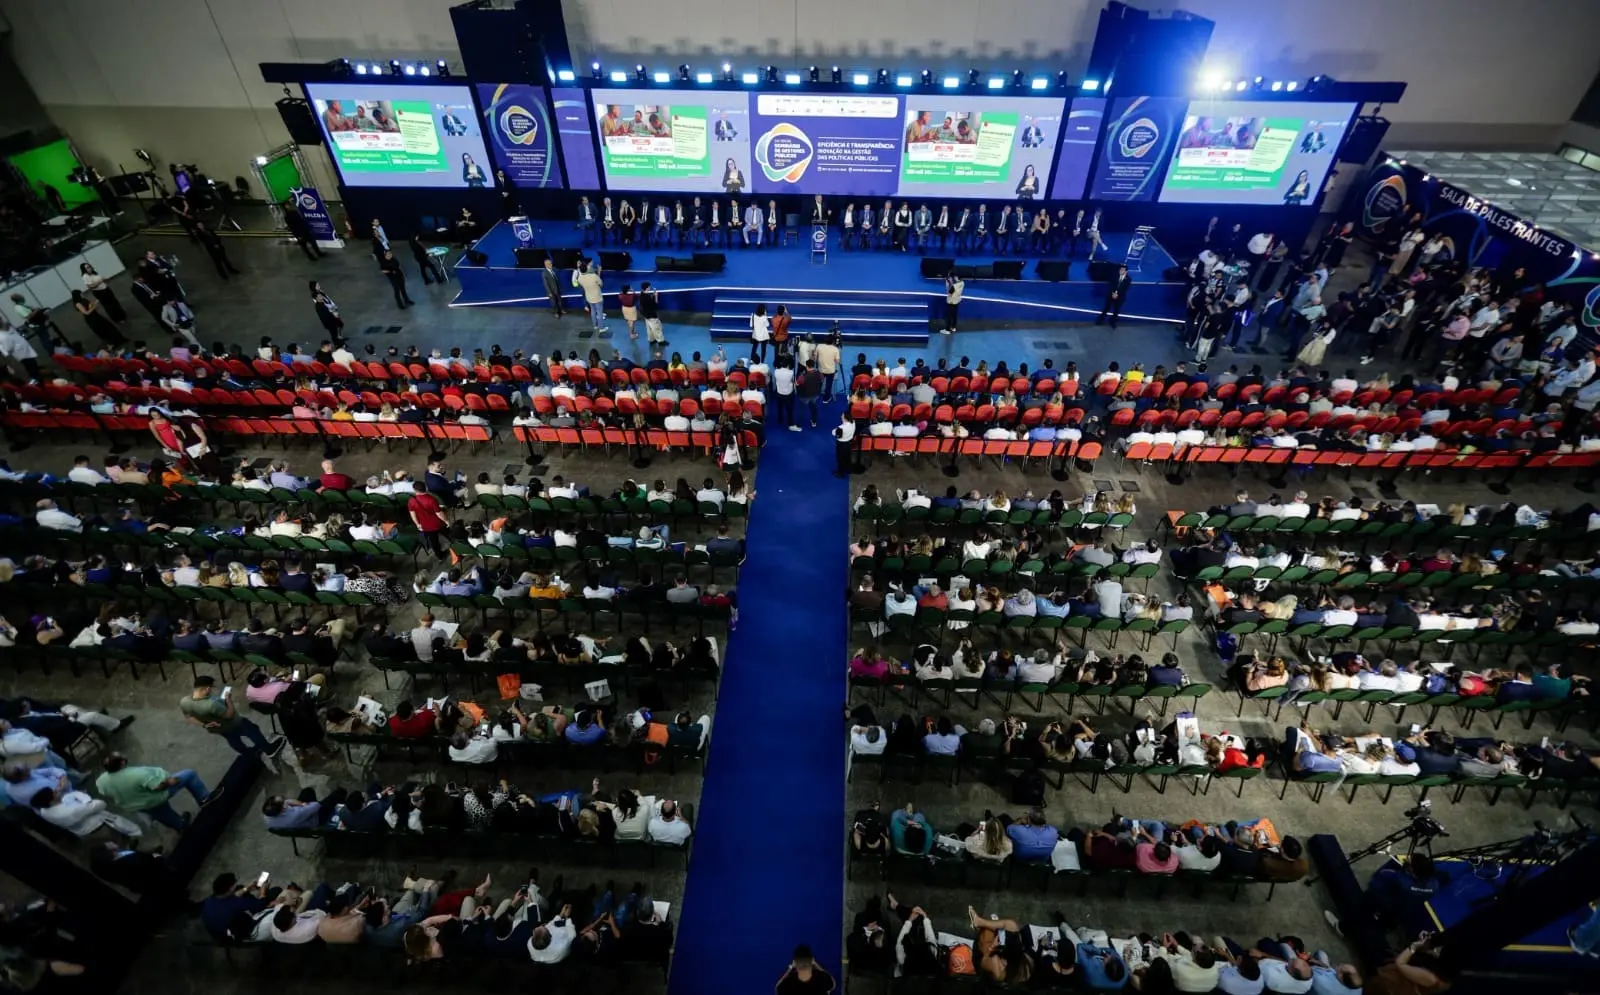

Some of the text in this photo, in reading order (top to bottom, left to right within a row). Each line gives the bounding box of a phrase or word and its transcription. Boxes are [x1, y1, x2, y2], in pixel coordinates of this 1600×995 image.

[1440, 186, 1566, 257] SALA DE PALESTRANTES
